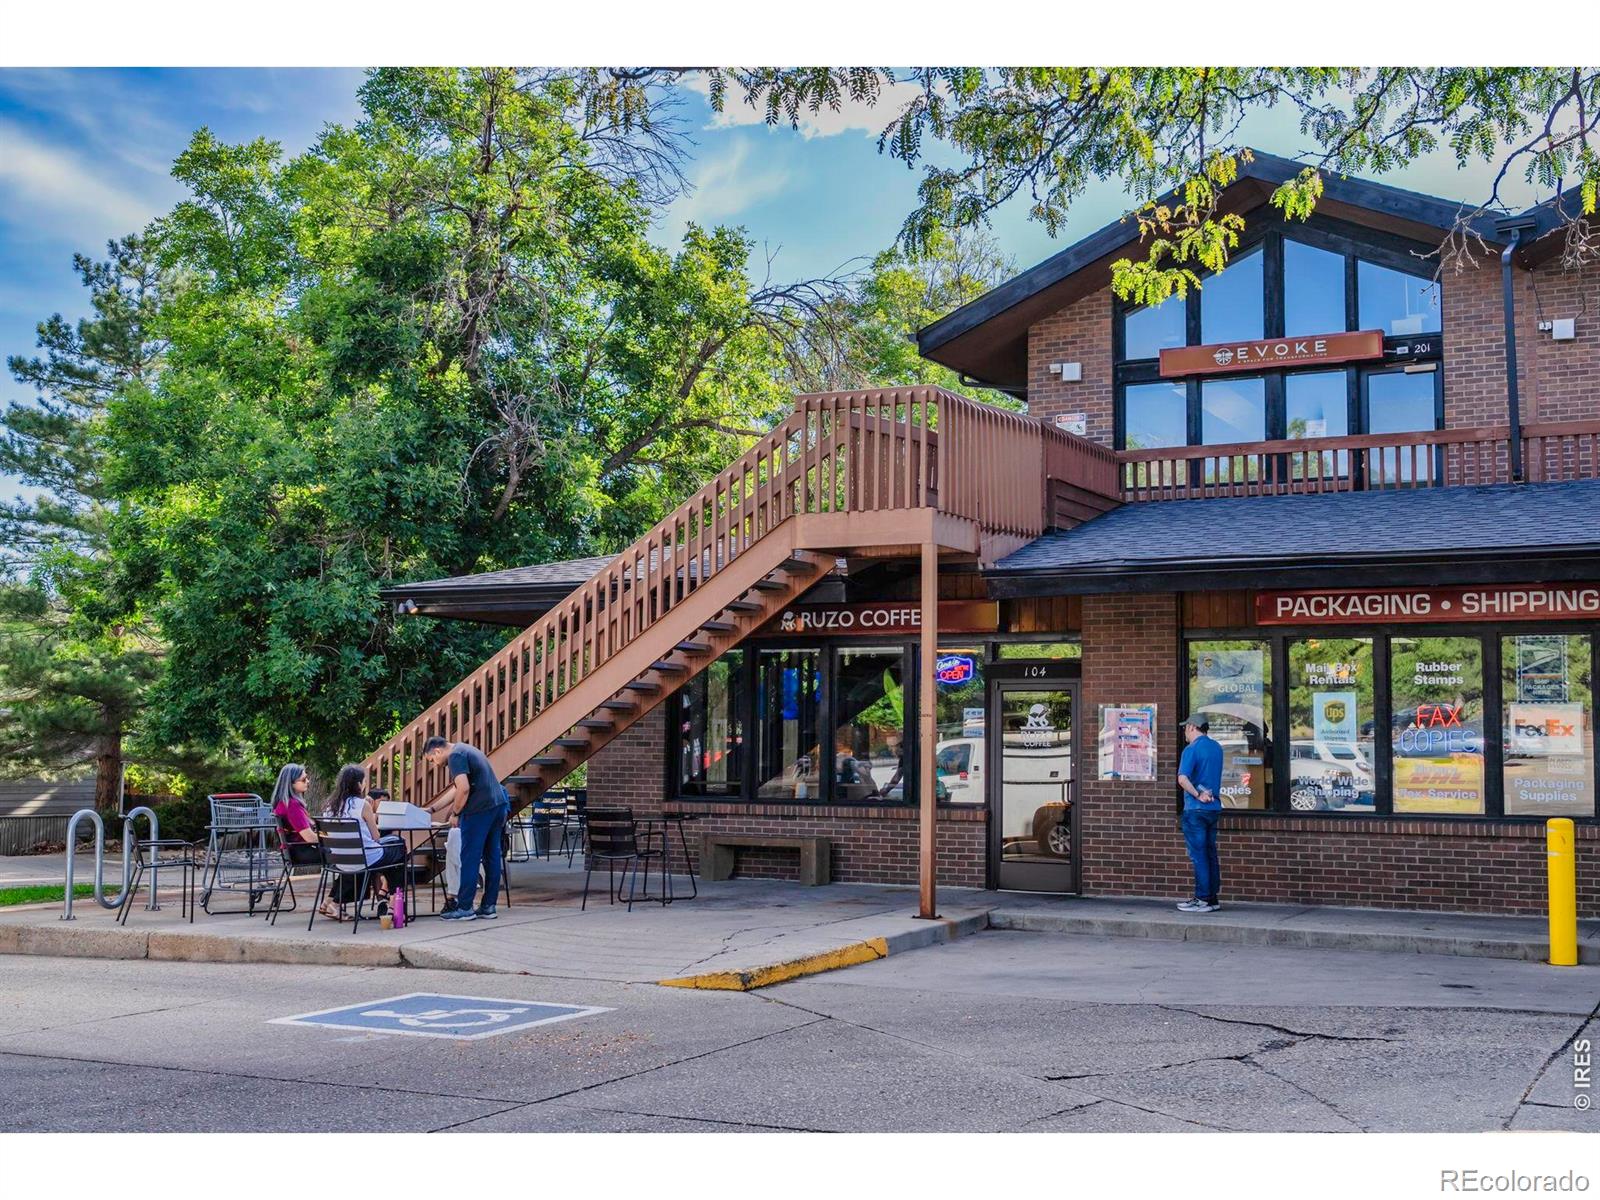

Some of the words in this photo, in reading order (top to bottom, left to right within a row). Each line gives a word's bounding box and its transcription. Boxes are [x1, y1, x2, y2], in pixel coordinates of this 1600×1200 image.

[1237, 340, 1327, 359] EVOKE
[1414, 343, 1430, 354] 201
[1277, 593, 1431, 617] PACKAGING
[1462, 589, 1600, 613] SHIPPING
[801, 611, 854, 628] RUZO
[859, 608, 922, 627] COFFE
[1024, 666, 1047, 677] 104
[1305, 663, 1328, 673] Mail
[1335, 662, 1357, 673] Box
[1415, 662, 1462, 672] Rubber
[940, 670, 963, 680] OPEN
[1309, 674, 1356, 685] Rentals
[1414, 675, 1464, 686] Stamps
[1217, 684, 1257, 693] GLOBAL
[1326, 706, 1345, 721] ups
[1416, 704, 1463, 728] FAX
[1514, 719, 1576, 736] FedEx
[1401, 730, 1477, 752] COPIES
[1298, 776, 1333, 786] World
[1337, 776, 1369, 786] Wide
[1514, 778, 1585, 790] Packaging
[1220, 785, 1252, 795] opies
[1307, 786, 1360, 799] Shipping
[1428, 788, 1477, 799] Service
[1519, 789, 1577, 802] Supplies
